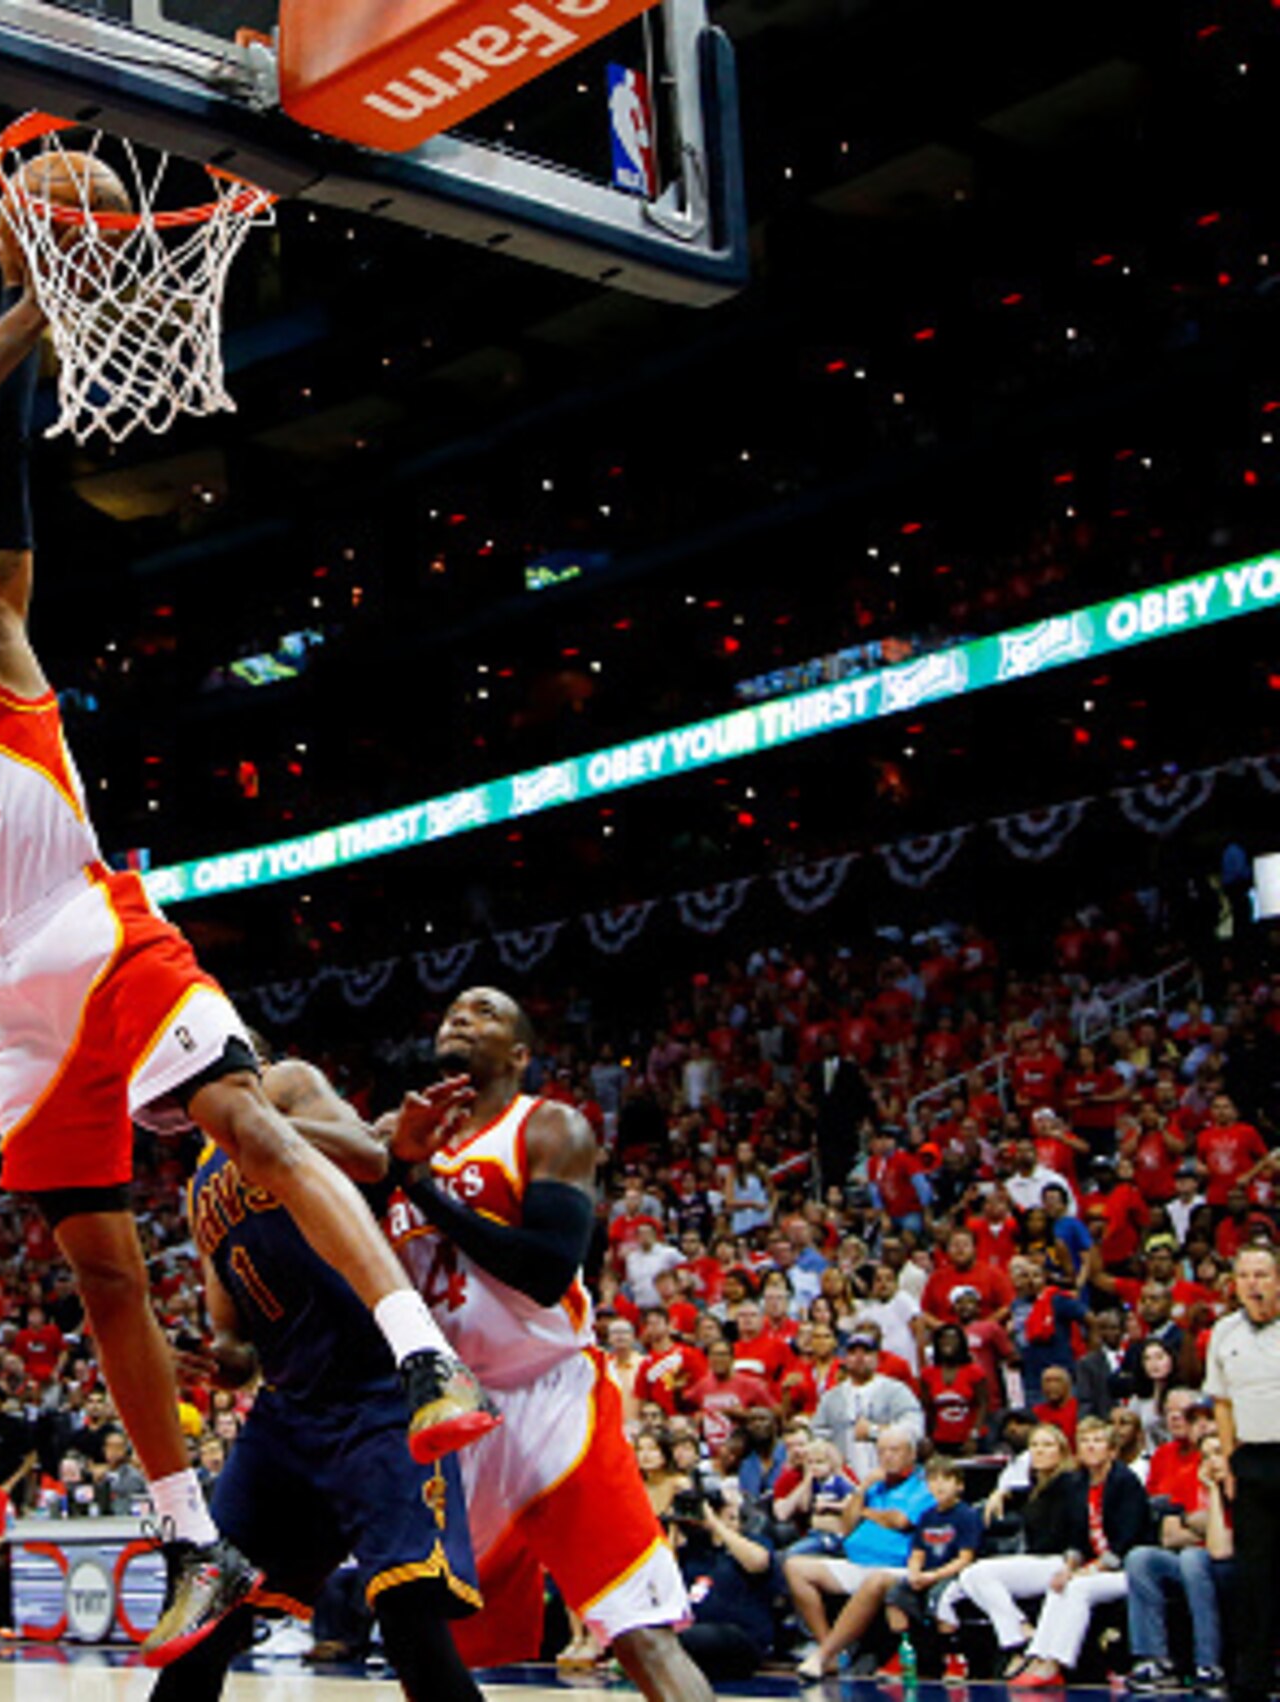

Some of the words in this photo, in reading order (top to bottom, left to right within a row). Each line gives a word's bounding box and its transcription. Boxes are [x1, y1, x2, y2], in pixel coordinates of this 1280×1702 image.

[362, 3, 579, 121] Farm
[1105, 575, 1219, 641] OBEY
[1223, 556, 1280, 607] YO
[588, 737, 667, 787] OBEY
[670, 710, 757, 764] YOUR
[758, 676, 878, 741] THIRST
[194, 850, 264, 889] OBEY
[265, 832, 336, 874] YOUR
[337, 807, 423, 857] THIRST
[231, 1247, 284, 1321] 1
